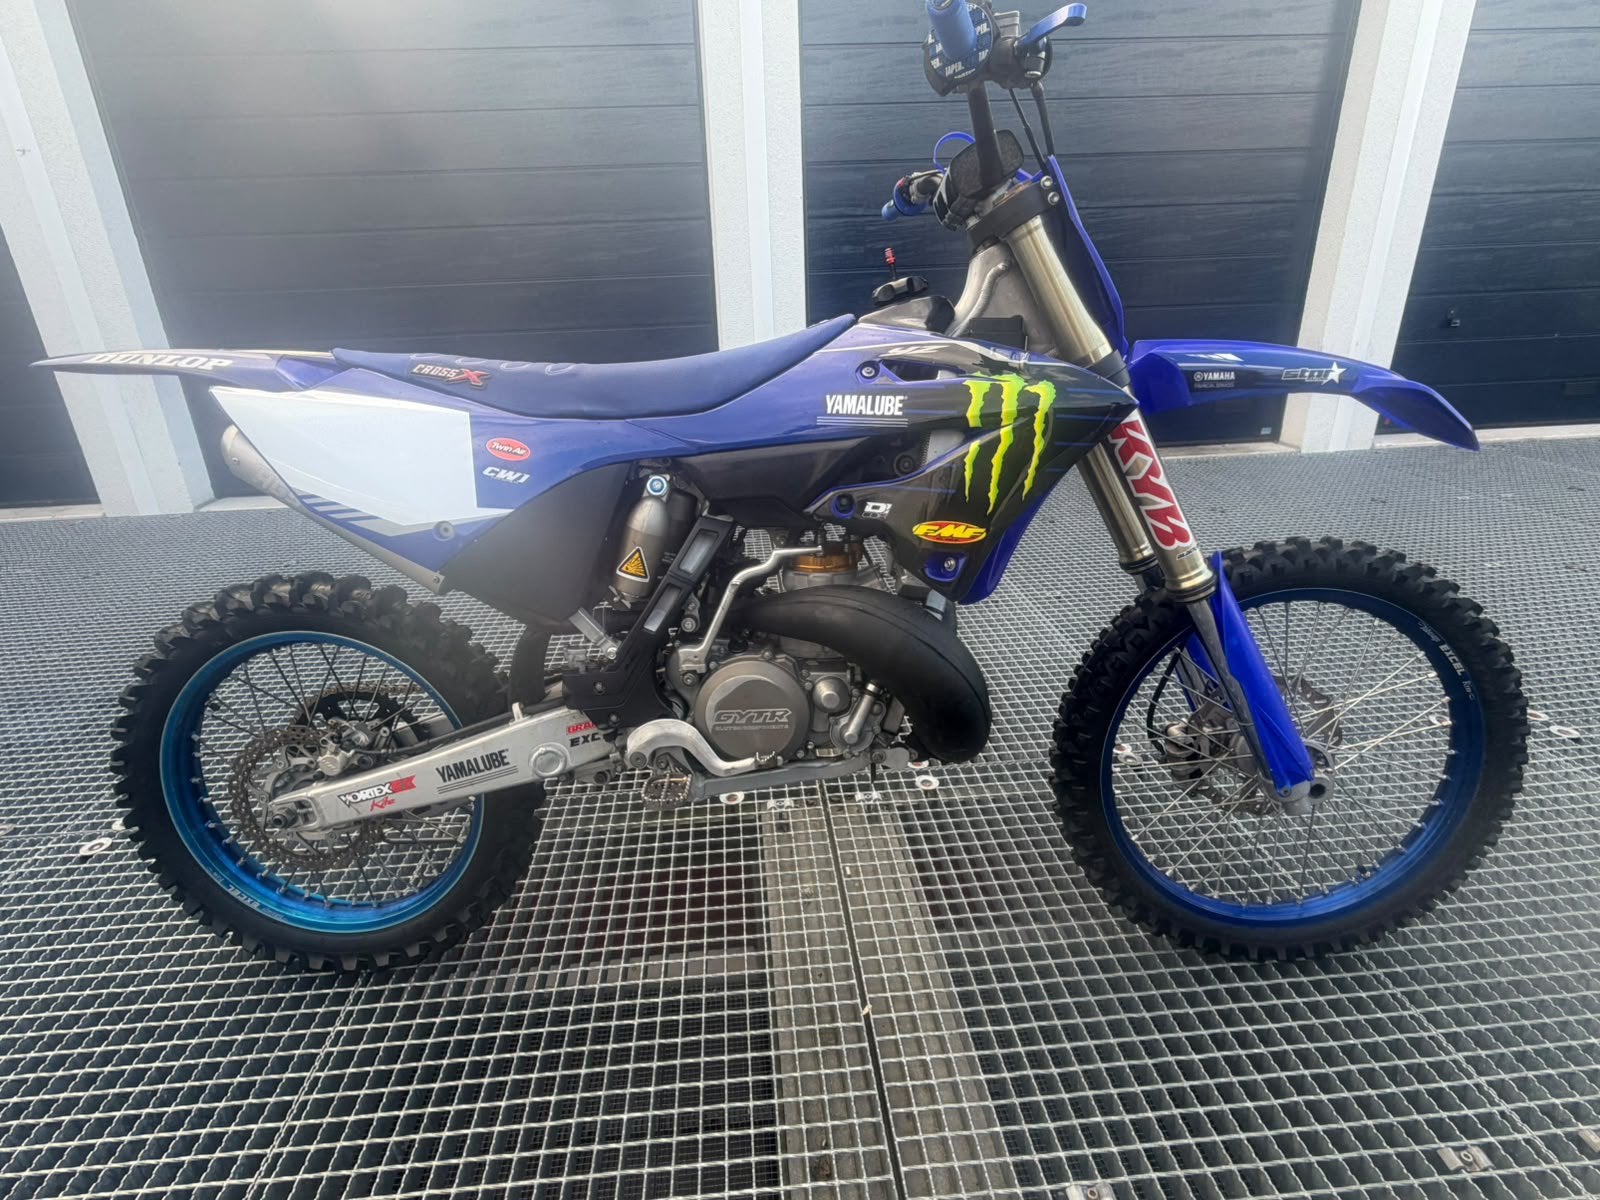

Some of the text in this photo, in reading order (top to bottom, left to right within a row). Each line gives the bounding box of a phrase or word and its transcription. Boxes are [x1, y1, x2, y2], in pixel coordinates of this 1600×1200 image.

[84, 353, 233, 370] DUNLOP
[1203, 371, 1236, 382] YAMAHA
[825, 394, 905, 416] YAMALUBE
[1107, 417, 1194, 549] KYB
[912, 524, 986, 539] FMF
[1438, 643, 1465, 677] EXCEL
[713, 708, 792, 725] GYTR
[436, 749, 510, 783] YAMALUBE
[338, 782, 393, 808] VORTEX
